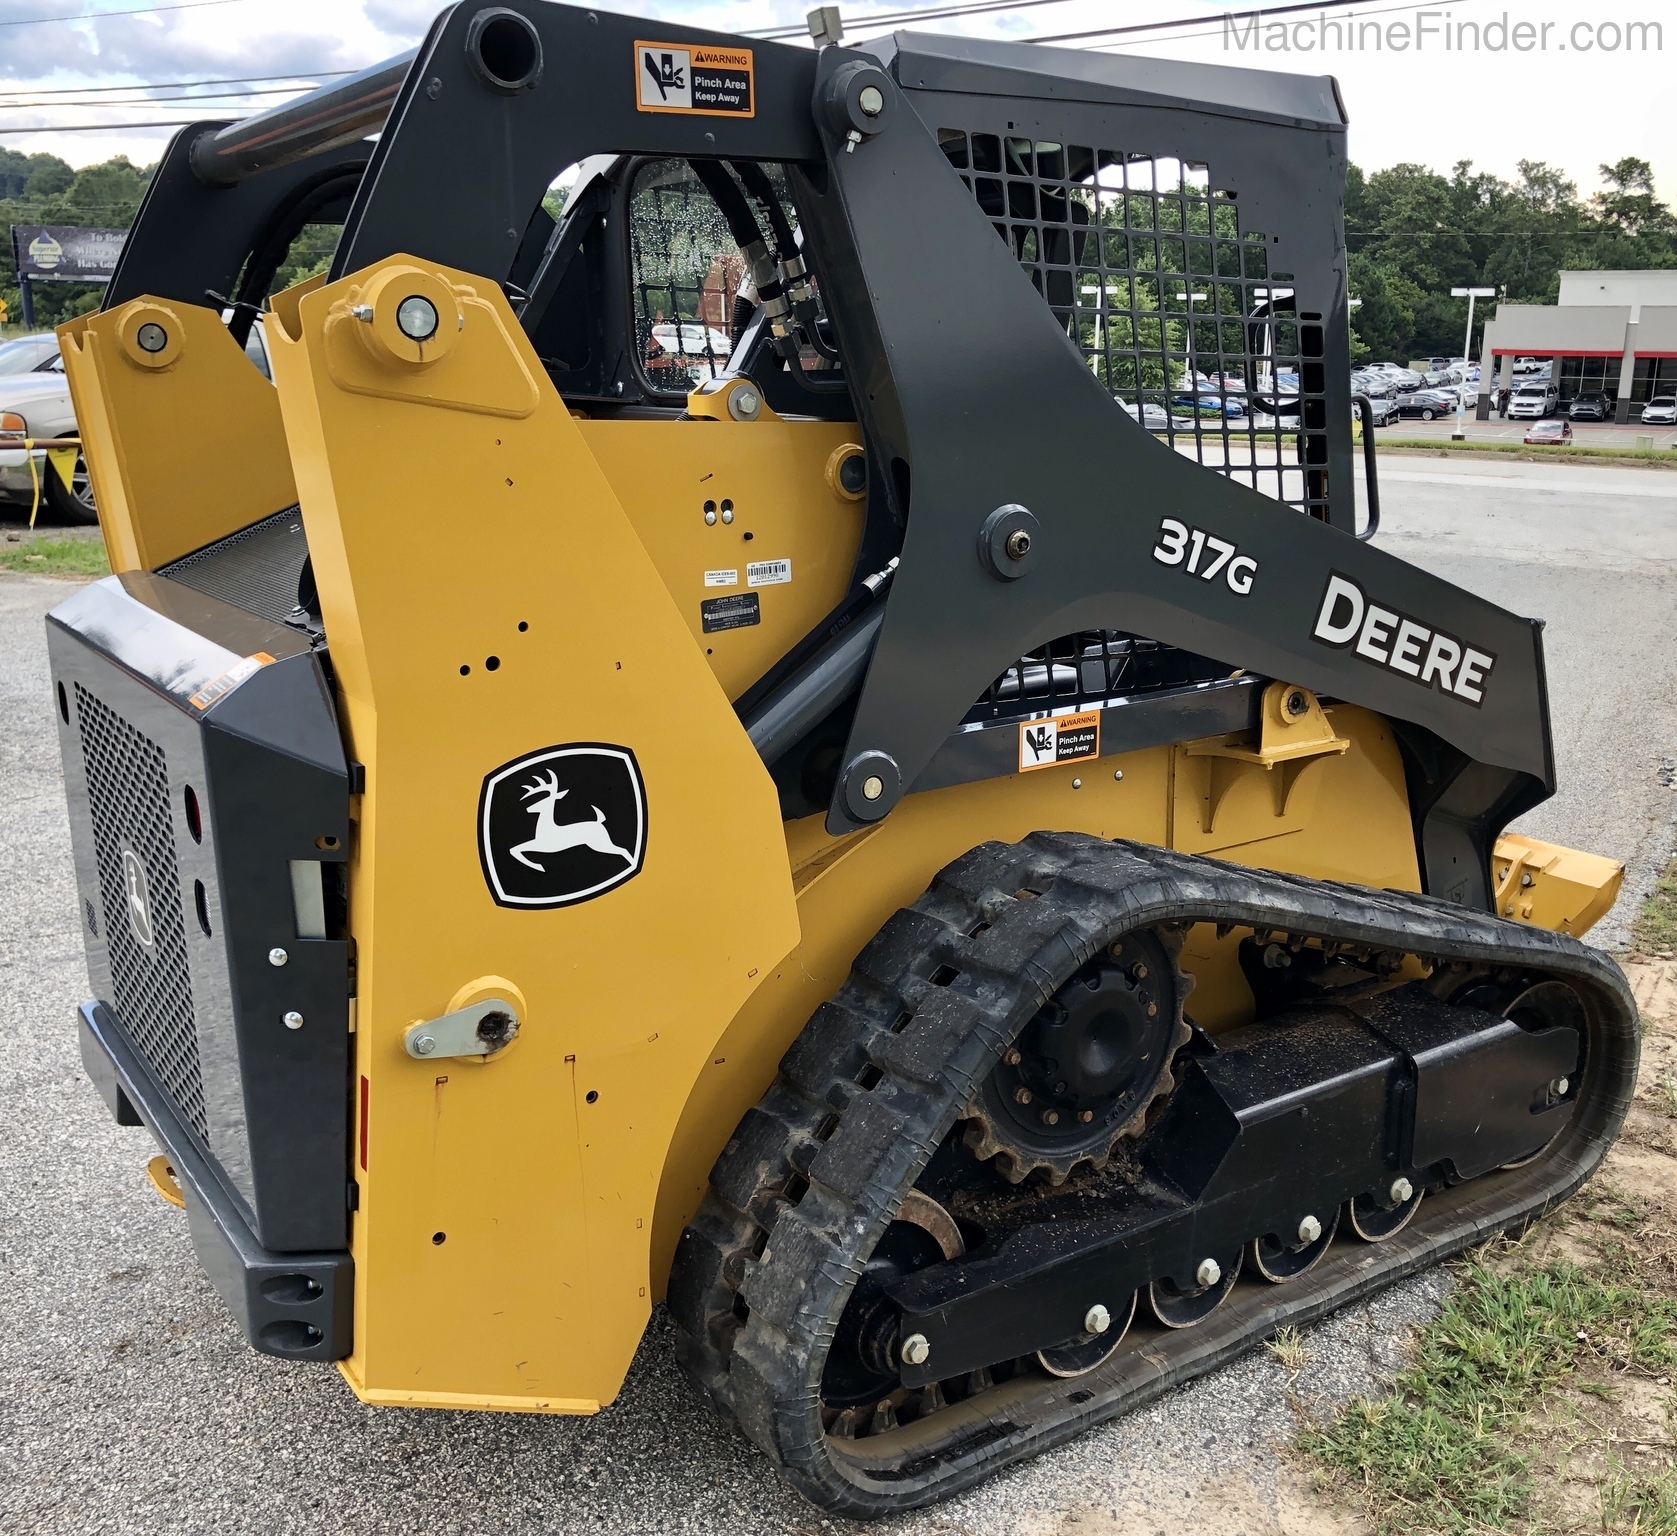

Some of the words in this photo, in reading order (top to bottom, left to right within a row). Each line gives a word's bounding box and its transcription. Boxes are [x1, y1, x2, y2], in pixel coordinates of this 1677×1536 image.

[705, 54, 747, 65] WARNING
[695, 77, 722, 88] Pinch
[725, 79, 746, 89] Area
[696, 92, 716, 102] Keep
[718, 93, 739, 104] Away
[1153, 518, 1258, 596] 317G
[1314, 575, 1493, 703] DEERE
[1066, 716, 1096, 726] WARNING
[1059, 736, 1078, 745] Pinch
[1079, 734, 1094, 742] Area
